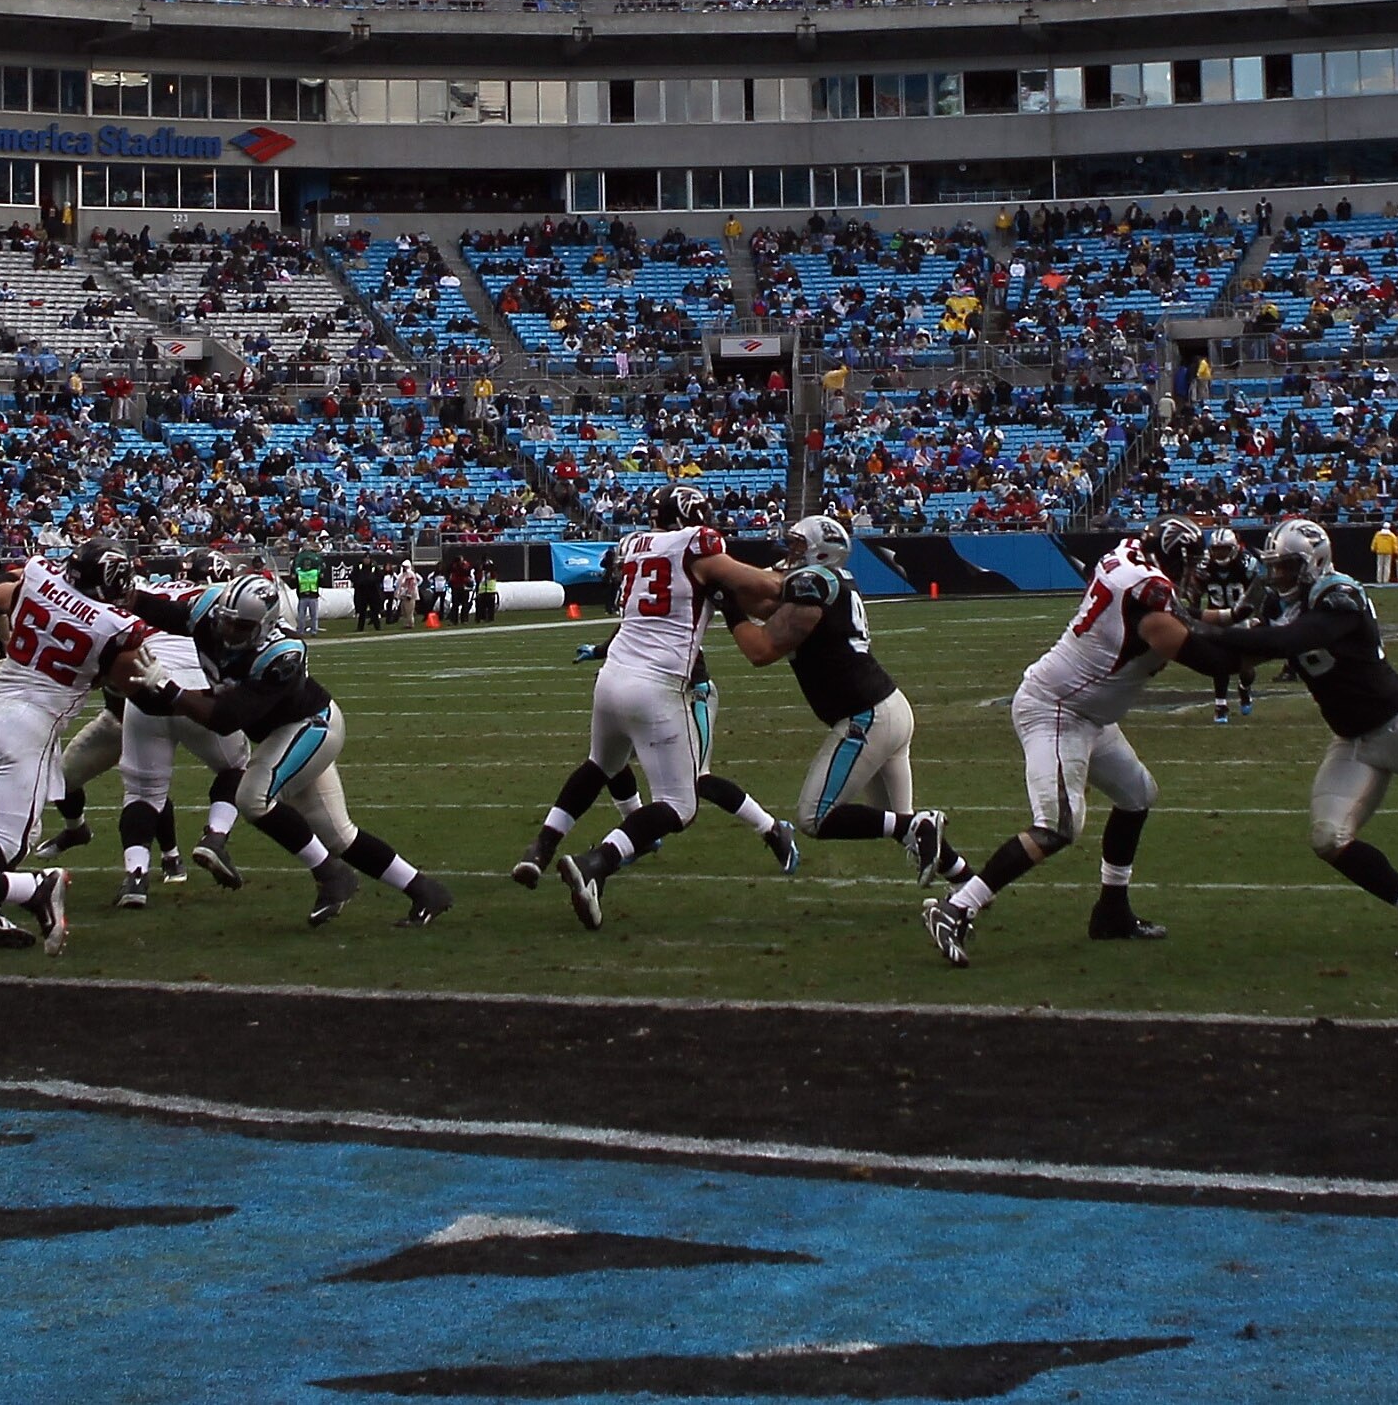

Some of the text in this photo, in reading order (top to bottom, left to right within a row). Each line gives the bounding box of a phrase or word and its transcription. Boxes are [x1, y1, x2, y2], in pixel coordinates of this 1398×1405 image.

[99, 125, 222, 160] Stadium
[173, 214, 188, 223] 323
[622, 557, 672, 617] 73
[8, 597, 93, 686] 62
